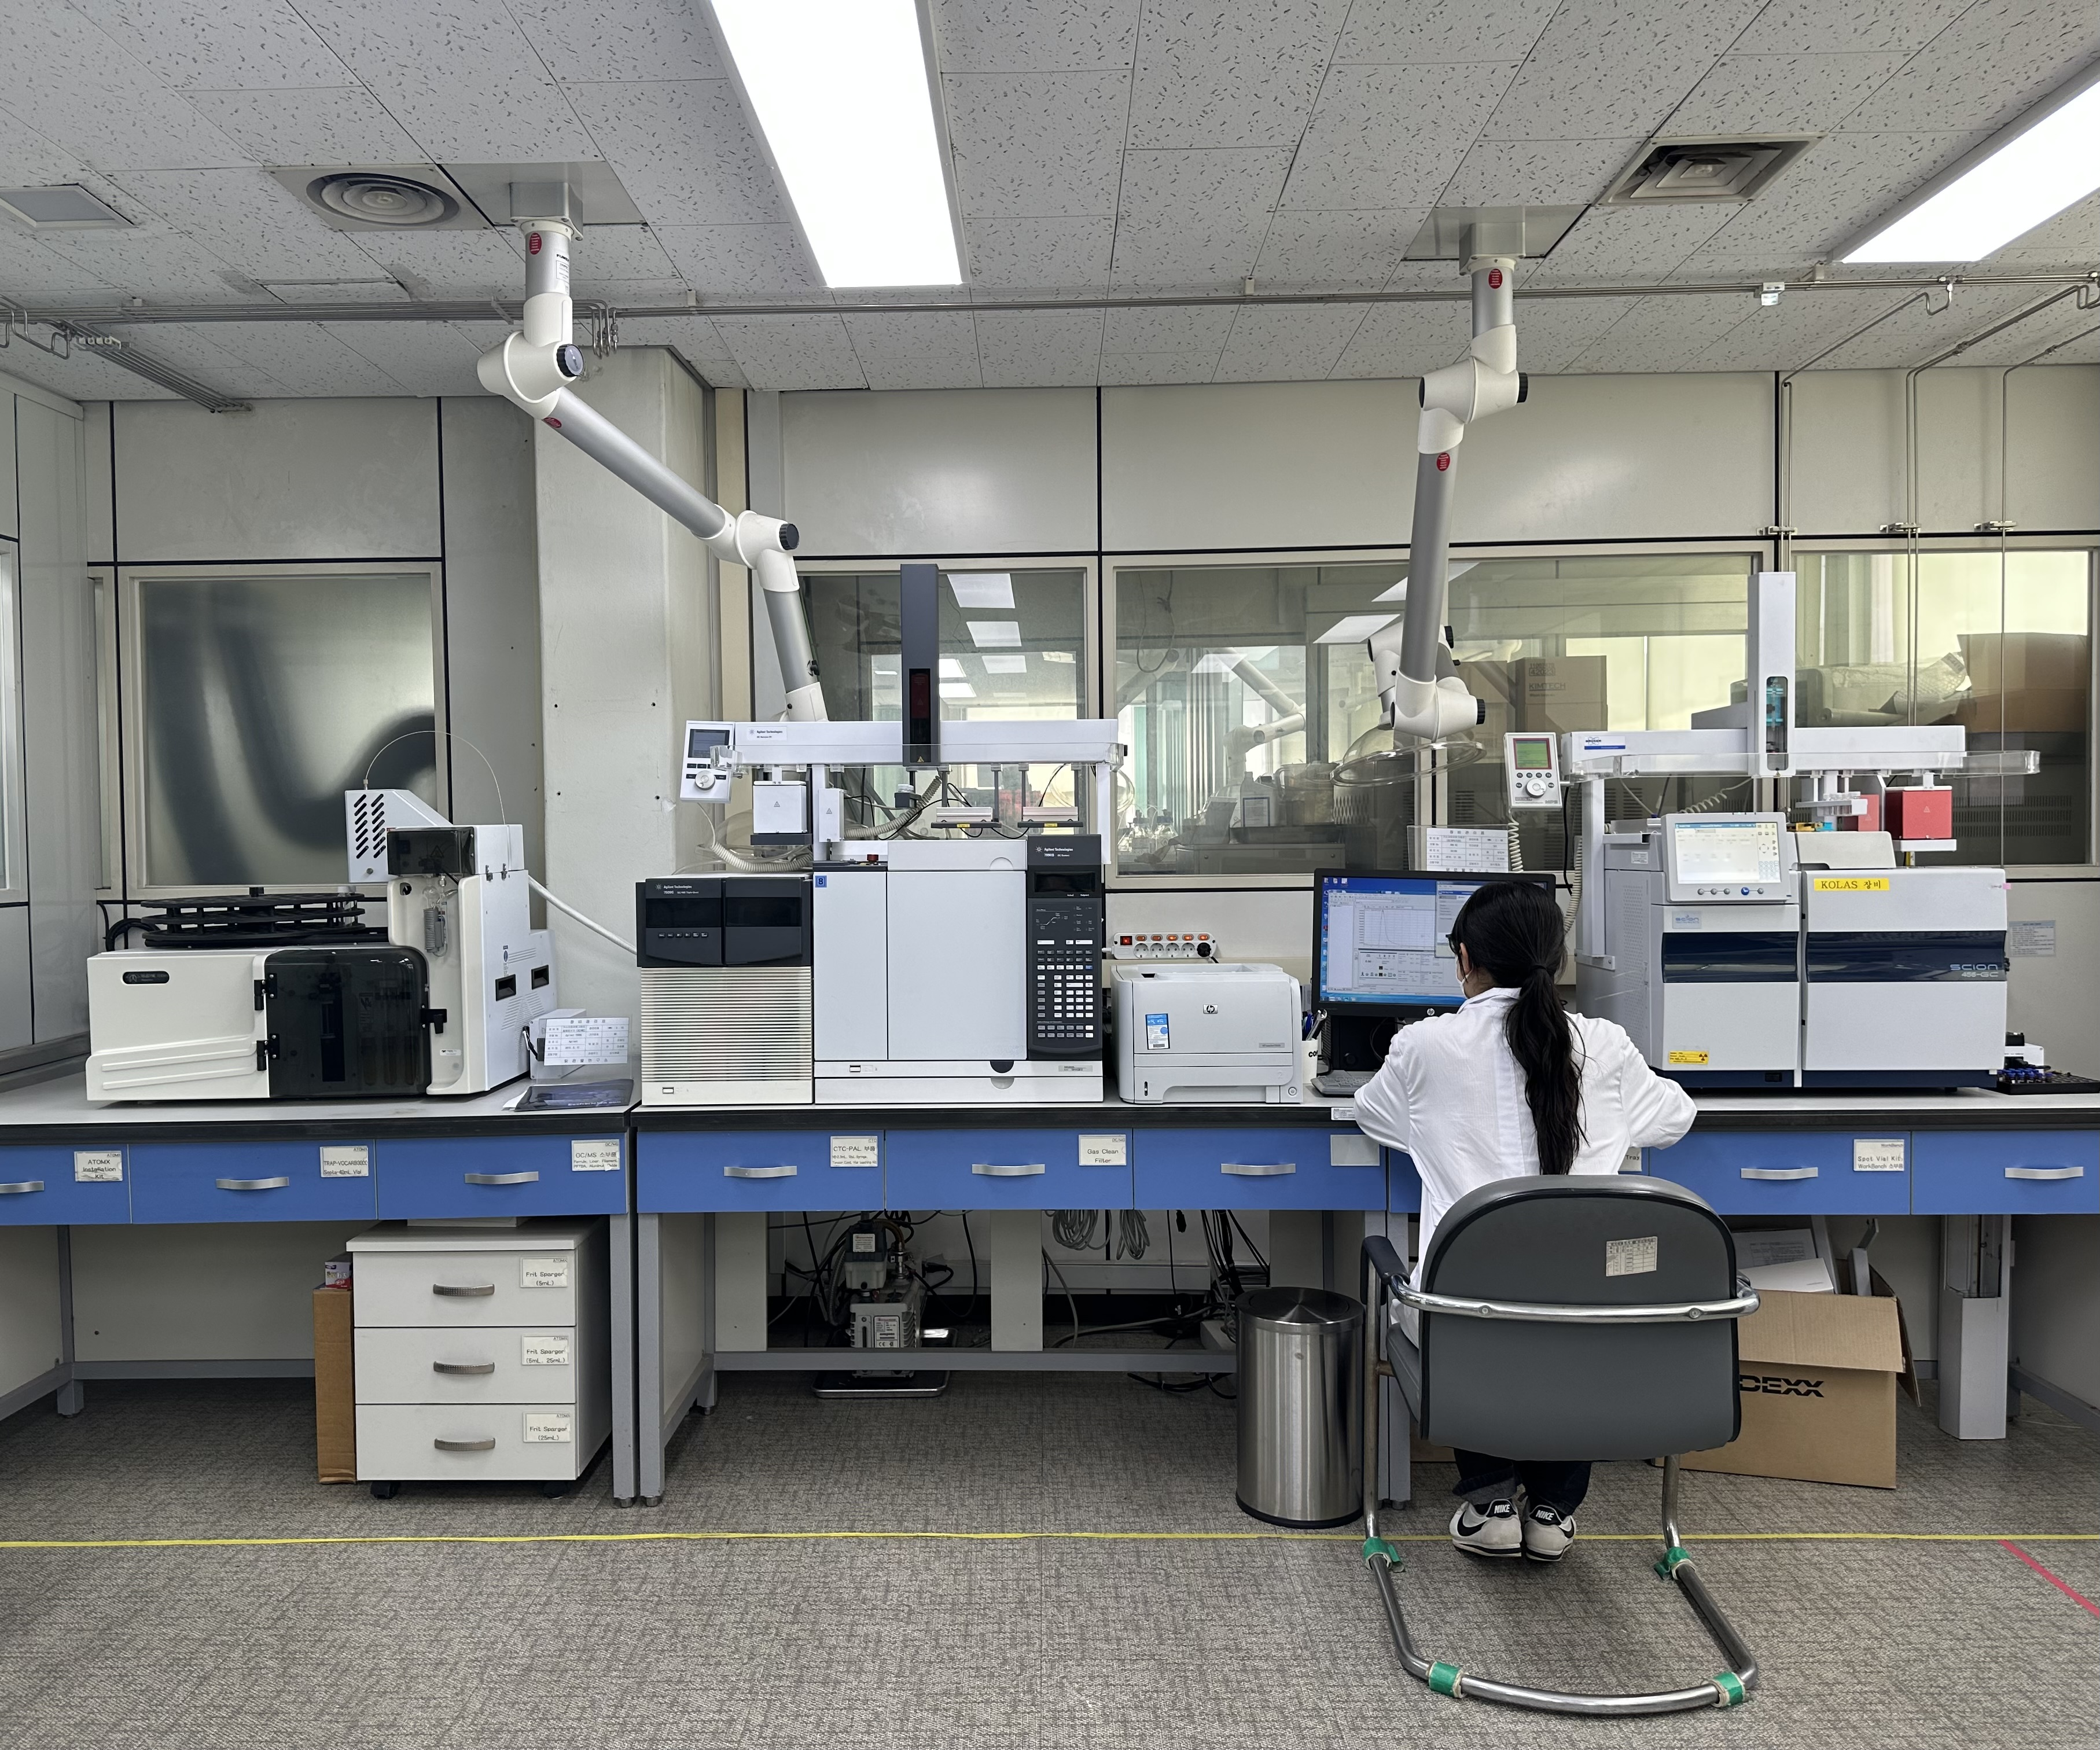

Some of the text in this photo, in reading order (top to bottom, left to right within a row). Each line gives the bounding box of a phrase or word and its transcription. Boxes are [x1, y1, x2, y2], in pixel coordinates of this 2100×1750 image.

[1821, 880, 1881, 889] KOLAS 장비
[1739, 1374, 1825, 1398] DEXX
[1494, 1504, 1510, 1514] NIKE
[1535, 1510, 1554, 1521] NIKE
